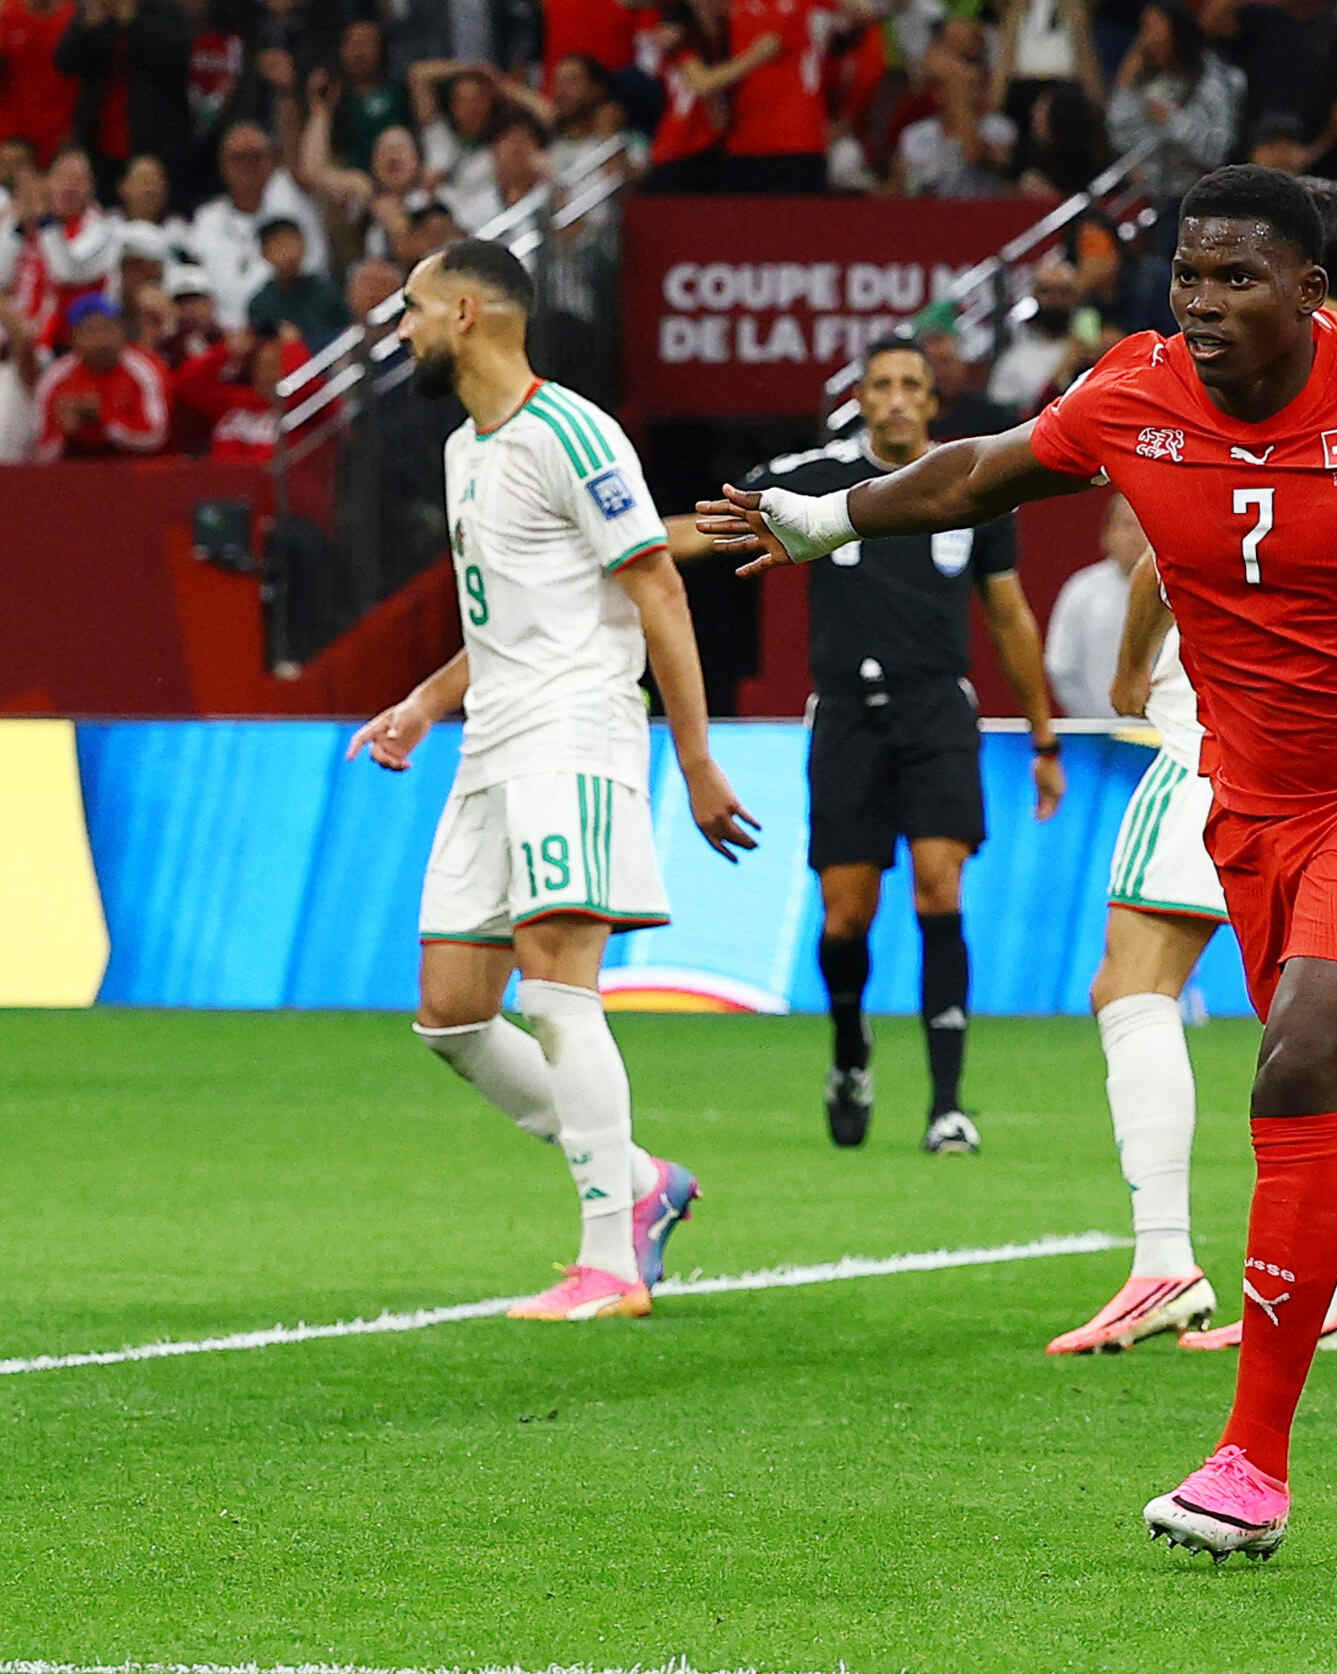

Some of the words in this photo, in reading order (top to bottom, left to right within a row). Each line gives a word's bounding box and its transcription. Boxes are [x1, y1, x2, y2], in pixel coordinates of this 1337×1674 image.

[662, 262, 840, 311] COUPE
[846, 262, 925, 311] DU
[659, 315, 729, 363] DE
[736, 315, 807, 363] LA
[1233, 488, 1275, 584] 7
[521, 834, 570, 898] 19
